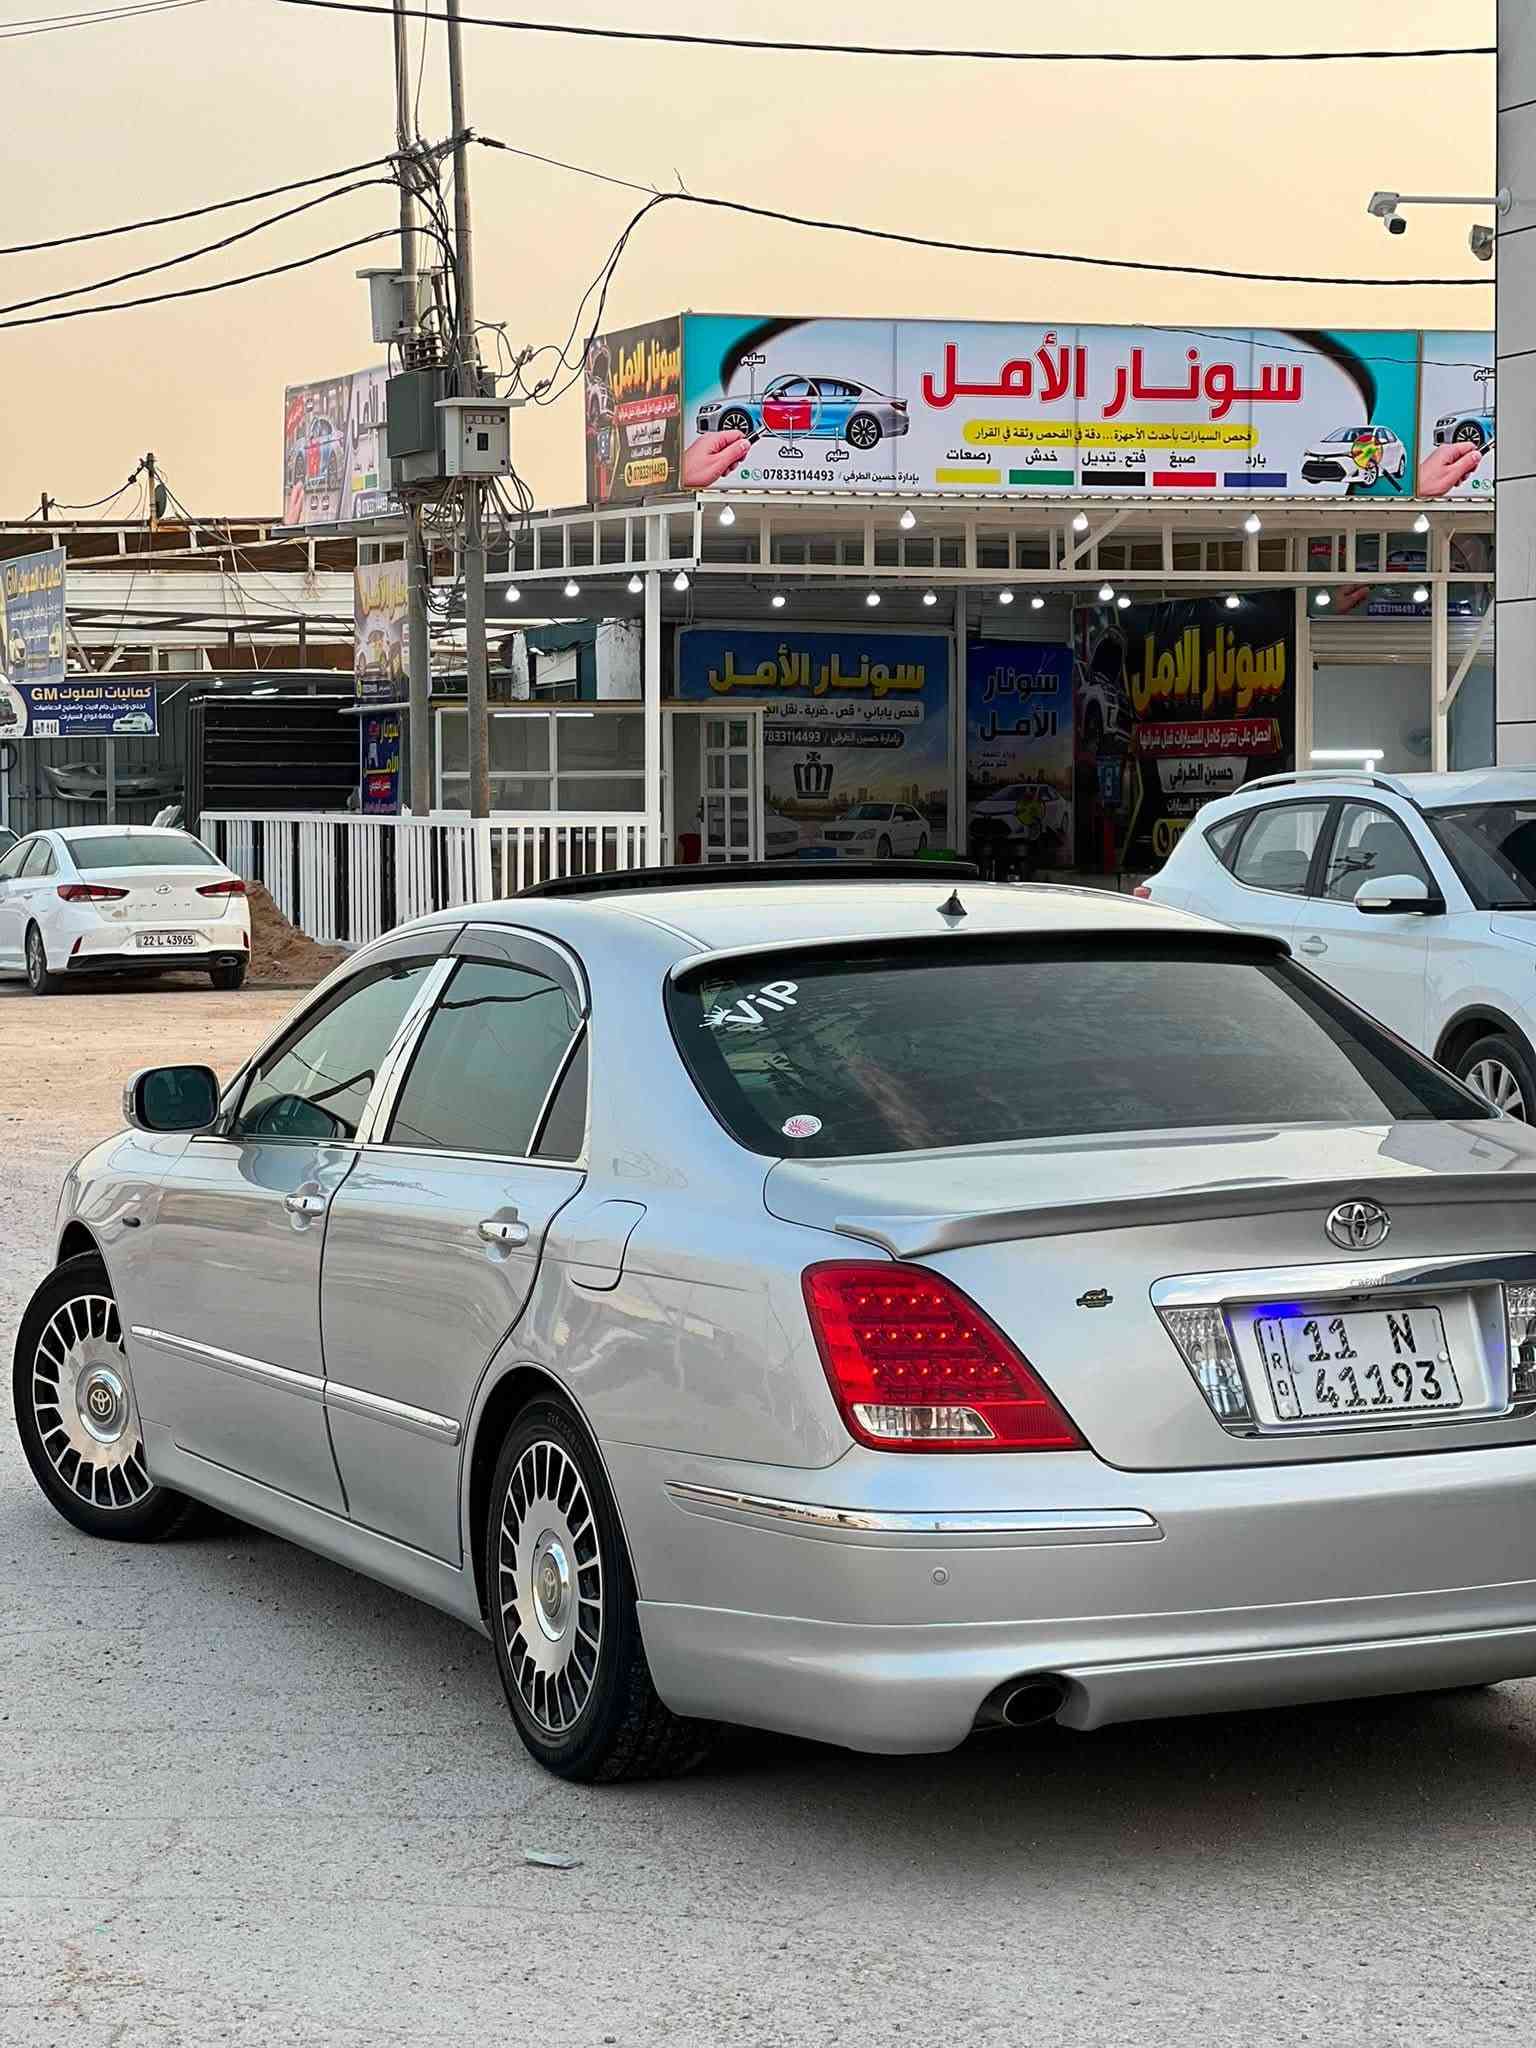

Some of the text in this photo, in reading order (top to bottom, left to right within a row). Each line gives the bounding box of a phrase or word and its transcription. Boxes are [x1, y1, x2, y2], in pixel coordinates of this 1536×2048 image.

[740, 352, 765, 366] سليم
[921, 331, 1303, 420] سونار الأمل
[975, 427, 1000, 440] القرار
[1002, 427, 1010, 442] في
[1014, 429, 1033, 440] وثقة
[1036, 428, 1071, 441] الفحص
[1085, 431, 1100, 441] دقة
[1147, 429, 1180, 442] بأحدث
[1180, 431, 1221, 444] السيارات
[1223, 433, 1252, 444] فحص
[826, 449, 849, 462] سليم
[946, 448, 991, 464] رصعات
[1026, 448, 1057, 465] خدش
[1125, 450, 1146, 467] فتح
[1169, 451, 1196, 467] صبغ
[1245, 453, 1266, 467] بارد
[763, 469, 834, 481] 07833114493
[872, 472, 896, 483] حسين
[709, 642, 925, 696] سونار الأمل
[1203, 624, 1285, 713] سونار
[983, 667, 1060, 703] سونار
[31, 687, 151, 701] كماليات الملوك GM
[894, 706, 919, 720] فحص
[1203, 765, 1232, 785] حسين
[143, 934, 194, 946] 22 L 43965
[1303, 1313, 1417, 1362] 11 N
[1316, 1361, 1443, 1408] 41193
